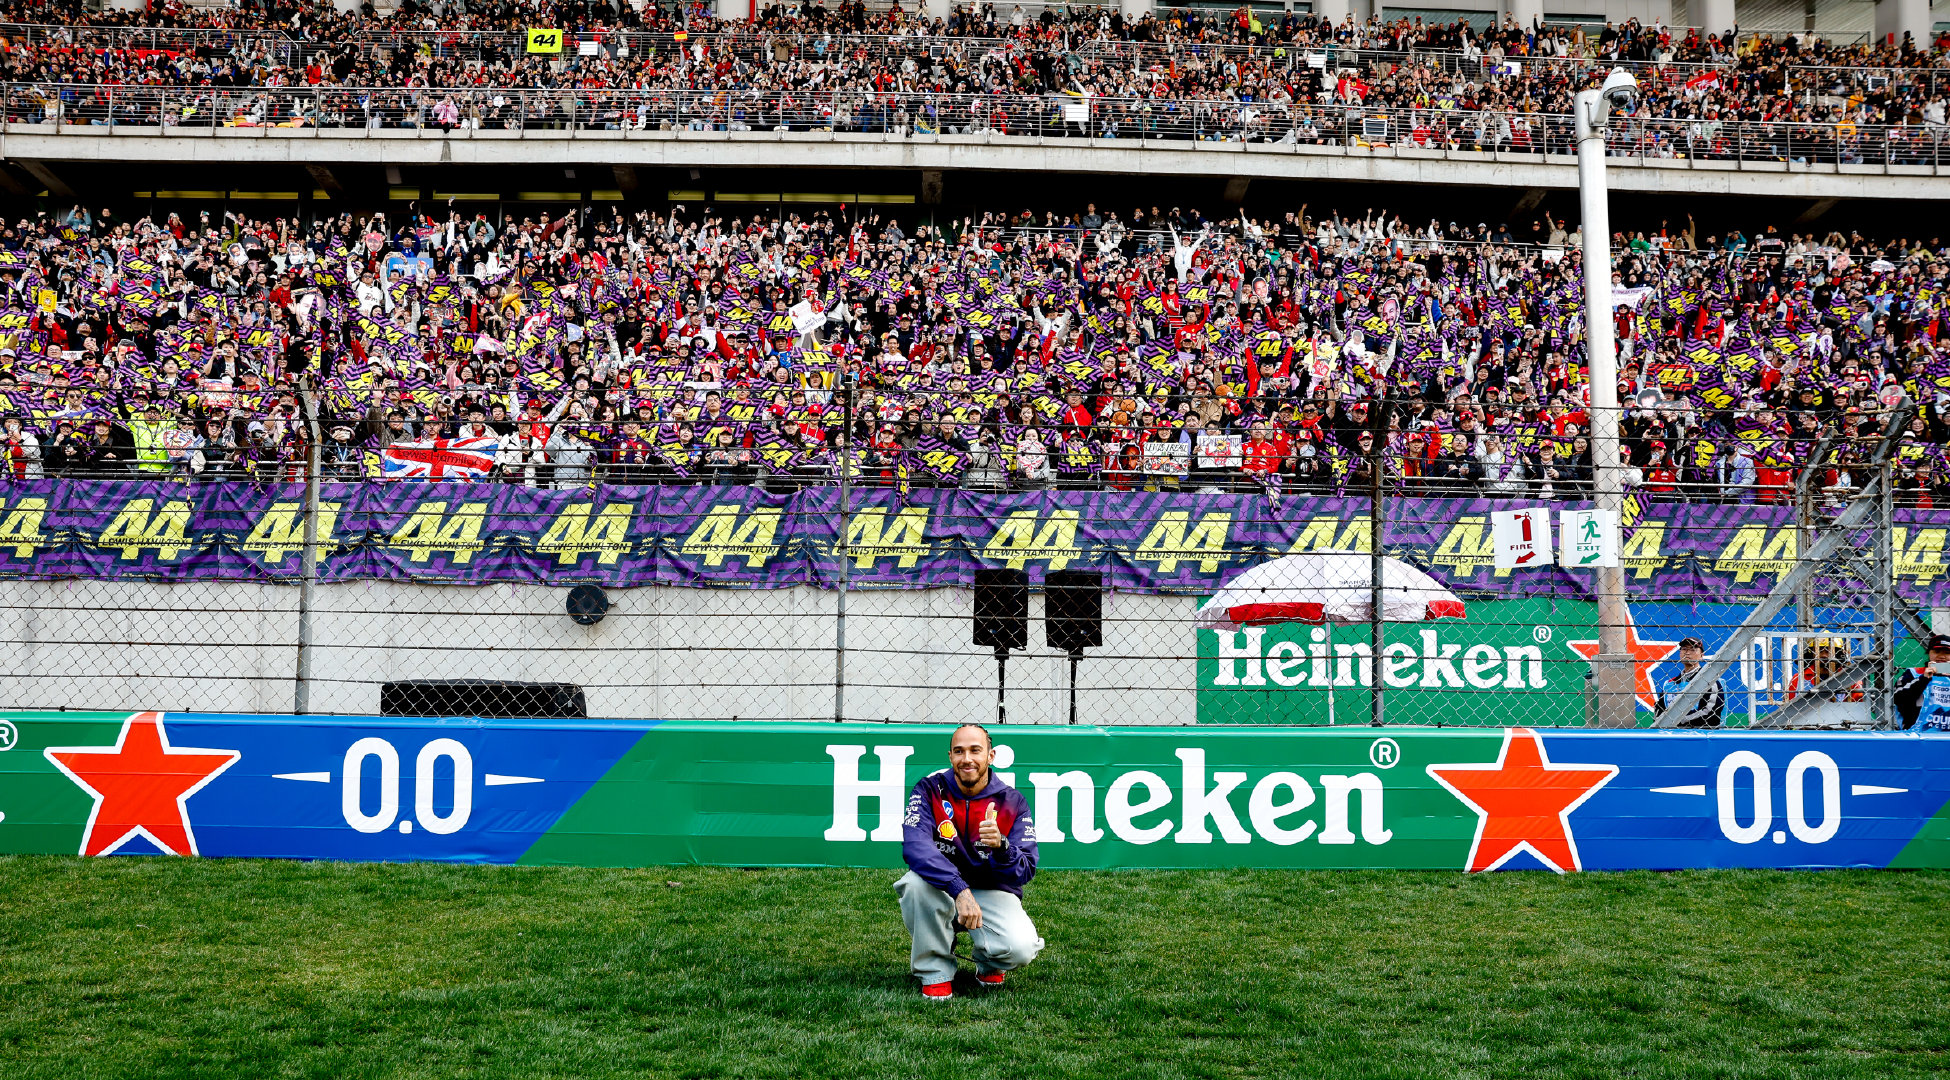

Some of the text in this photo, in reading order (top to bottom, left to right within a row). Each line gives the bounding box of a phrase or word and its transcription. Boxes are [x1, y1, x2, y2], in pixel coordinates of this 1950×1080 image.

[533, 34, 556, 47] 44
[128, 260, 152, 273] 44
[1187, 288, 1208, 300] 44
[1143, 296, 1163, 314] 44
[769, 316, 792, 331] 44
[966, 311, 993, 328] 44
[358, 319, 379, 338] 44
[386, 327, 403, 344] 44
[1255, 341, 1282, 356] 44
[1689, 348, 1720, 365] 44
[1064, 362, 1093, 379] 44
[1149, 355, 1174, 377] 44
[532, 372, 560, 390] 44
[1658, 370, 1686, 384] 44
[727, 405, 755, 419] 44
[1032, 396, 1057, 417] 44
[662, 443, 689, 464] 44
[761, 442, 793, 467] 44
[923, 452, 957, 472] 44
[0, 498, 48, 558] 4
[98, 499, 196, 560] 44
[243, 502, 341, 563] 44
[389, 501, 488, 563] 44
[535, 503, 634, 564] 44
[680, 505, 783, 567] 44
[102, 537, 191, 548] LEWIS HAMILTON
[247, 541, 277, 549] LEWIS
[393, 539, 480, 550] LEWIS HAMILTON
[832, 506, 932, 568] 44
[983, 509, 1083, 570] 44
[1135, 511, 1232, 573] 44
[540, 542, 628, 551] LEWIS HAMILTON
[685, 544, 777, 554] LEWIS HAMILTON
[872, 546, 928, 555] HAMILTON
[987, 549, 1078, 557] LEWIS HAMILTON
[1139, 551, 1171, 559] LEWIS
[1509, 543, 1533, 551] FIRE
[1435, 556, 1469, 564] LEWIS
[1718, 561, 1750, 569] LEWIS
[1896, 564, 1943, 573] HAMILTON
[1214, 628, 1547, 688] Heineken
[342, 737, 473, 835] 0.0
[1716, 750, 1842, 845] 0.0
